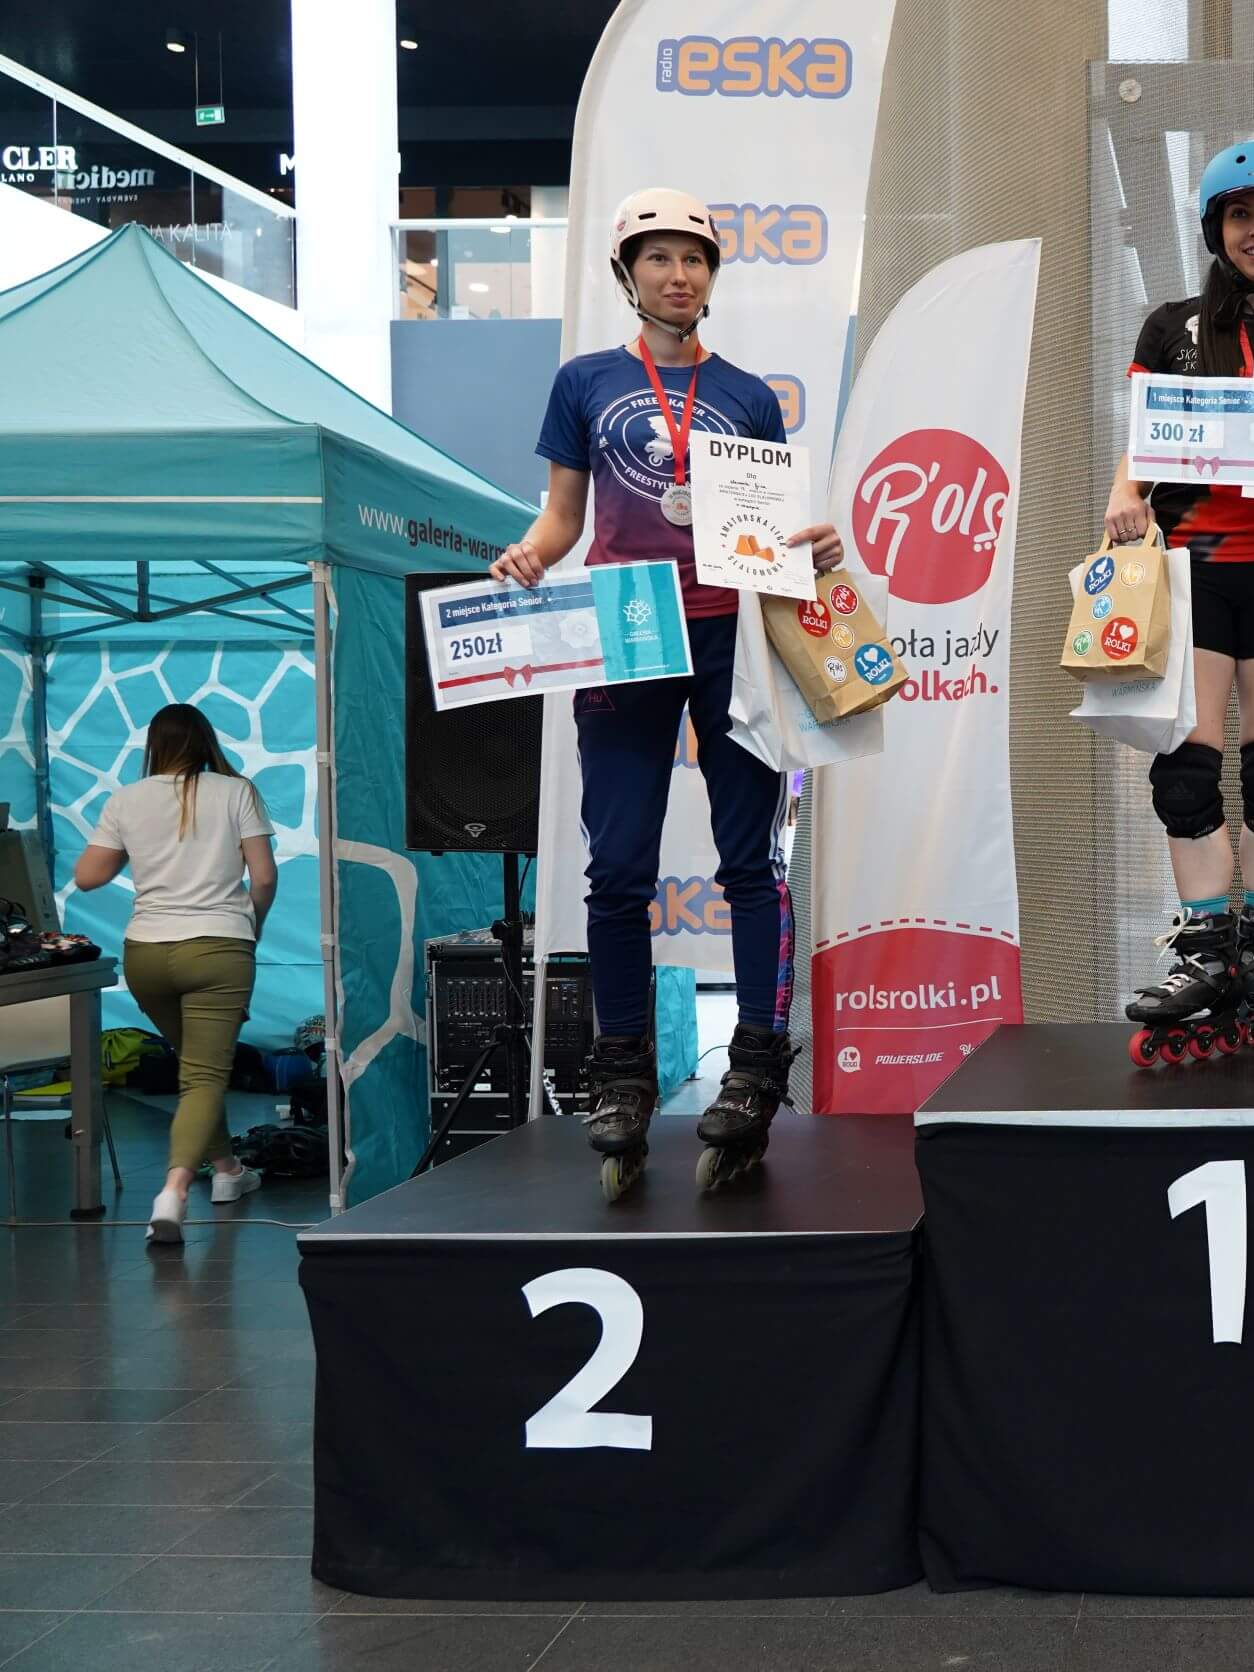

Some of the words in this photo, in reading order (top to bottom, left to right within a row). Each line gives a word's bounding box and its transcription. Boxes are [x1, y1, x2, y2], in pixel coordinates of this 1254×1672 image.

[661, 48, 673, 84] radio
[677, 41, 847, 94] eska
[712, 208, 824, 261] ska
[1186, 395, 1217, 406] Kategoria
[1150, 422, 1184, 441] 300
[1189, 424, 1205, 443] zł
[709, 440, 792, 468] DYPLOM
[452, 604, 481, 618] miejsce
[518, 595, 543, 606] Senior
[802, 615, 828, 629] ROLKI
[450, 632, 503, 661] 250zł
[891, 626, 935, 659] oła
[1104, 636, 1132, 653] ROLKI
[865, 658, 891, 682] ROLKI
[900, 664, 998, 702] olkach.
[835, 976, 1002, 1011] rolsrolki.pl
[875, 1052, 944, 1065] POWERSLIDE
[1167, 1159, 1247, 1345] 1
[522, 1267, 653, 1450] 2
